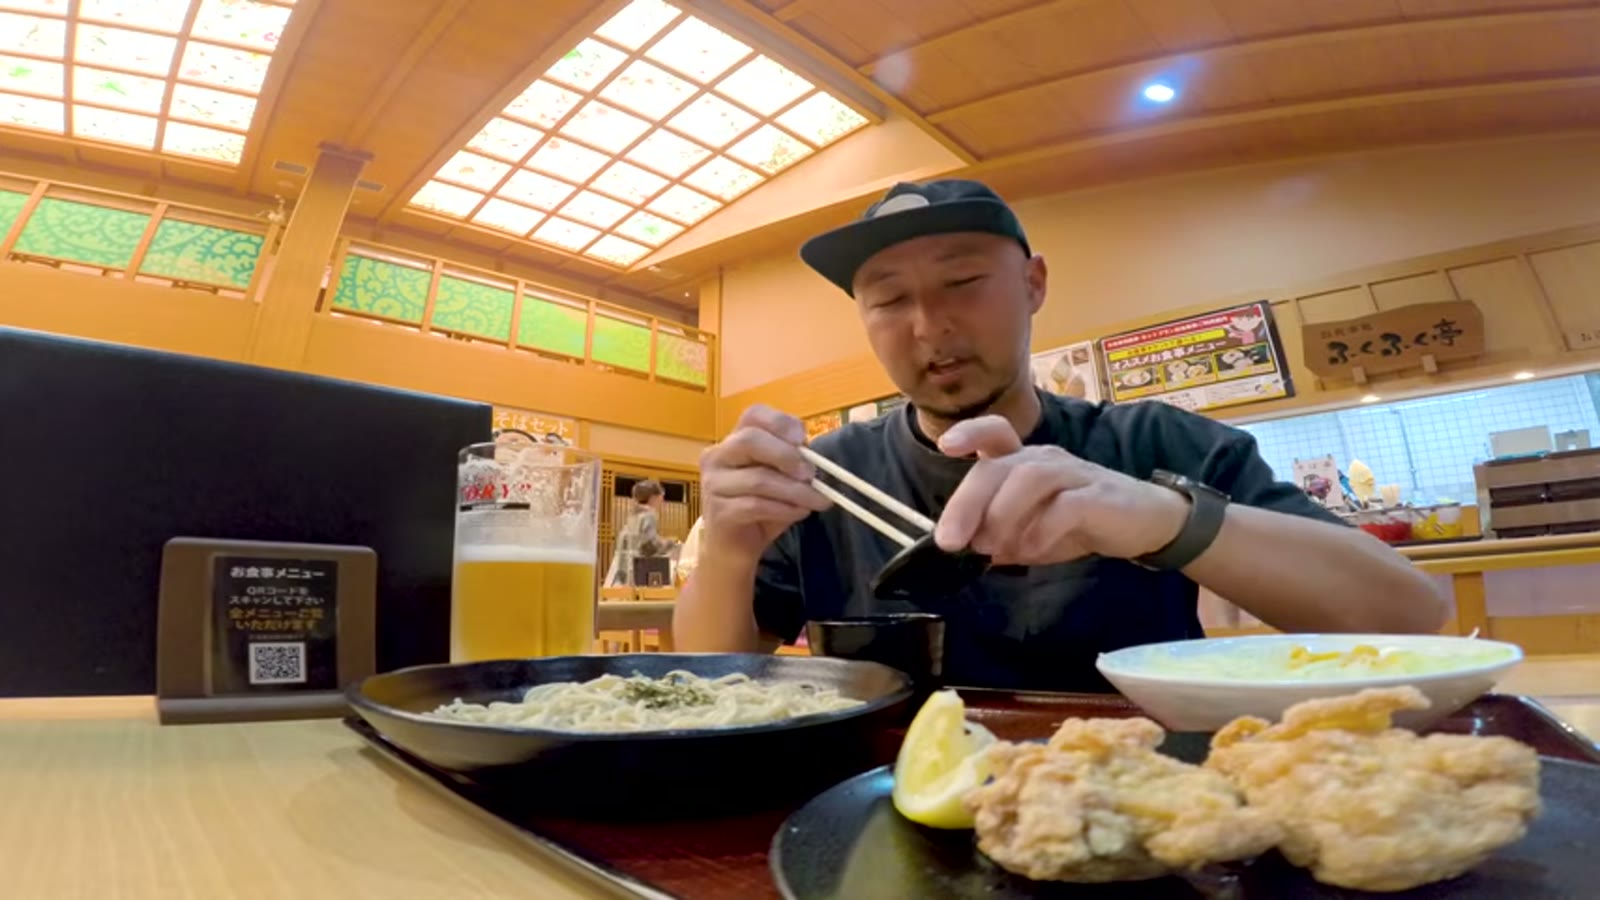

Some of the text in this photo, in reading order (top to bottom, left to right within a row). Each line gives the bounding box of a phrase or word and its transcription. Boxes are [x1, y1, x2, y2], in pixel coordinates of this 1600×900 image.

[1327, 318, 1464, 366] ふくふく亭
[1109, 340, 1227, 371] オススメお食事メニュー
[230, 566, 325, 578] お食事メニュー
[228, 596, 325, 605] スキャンして下さい
